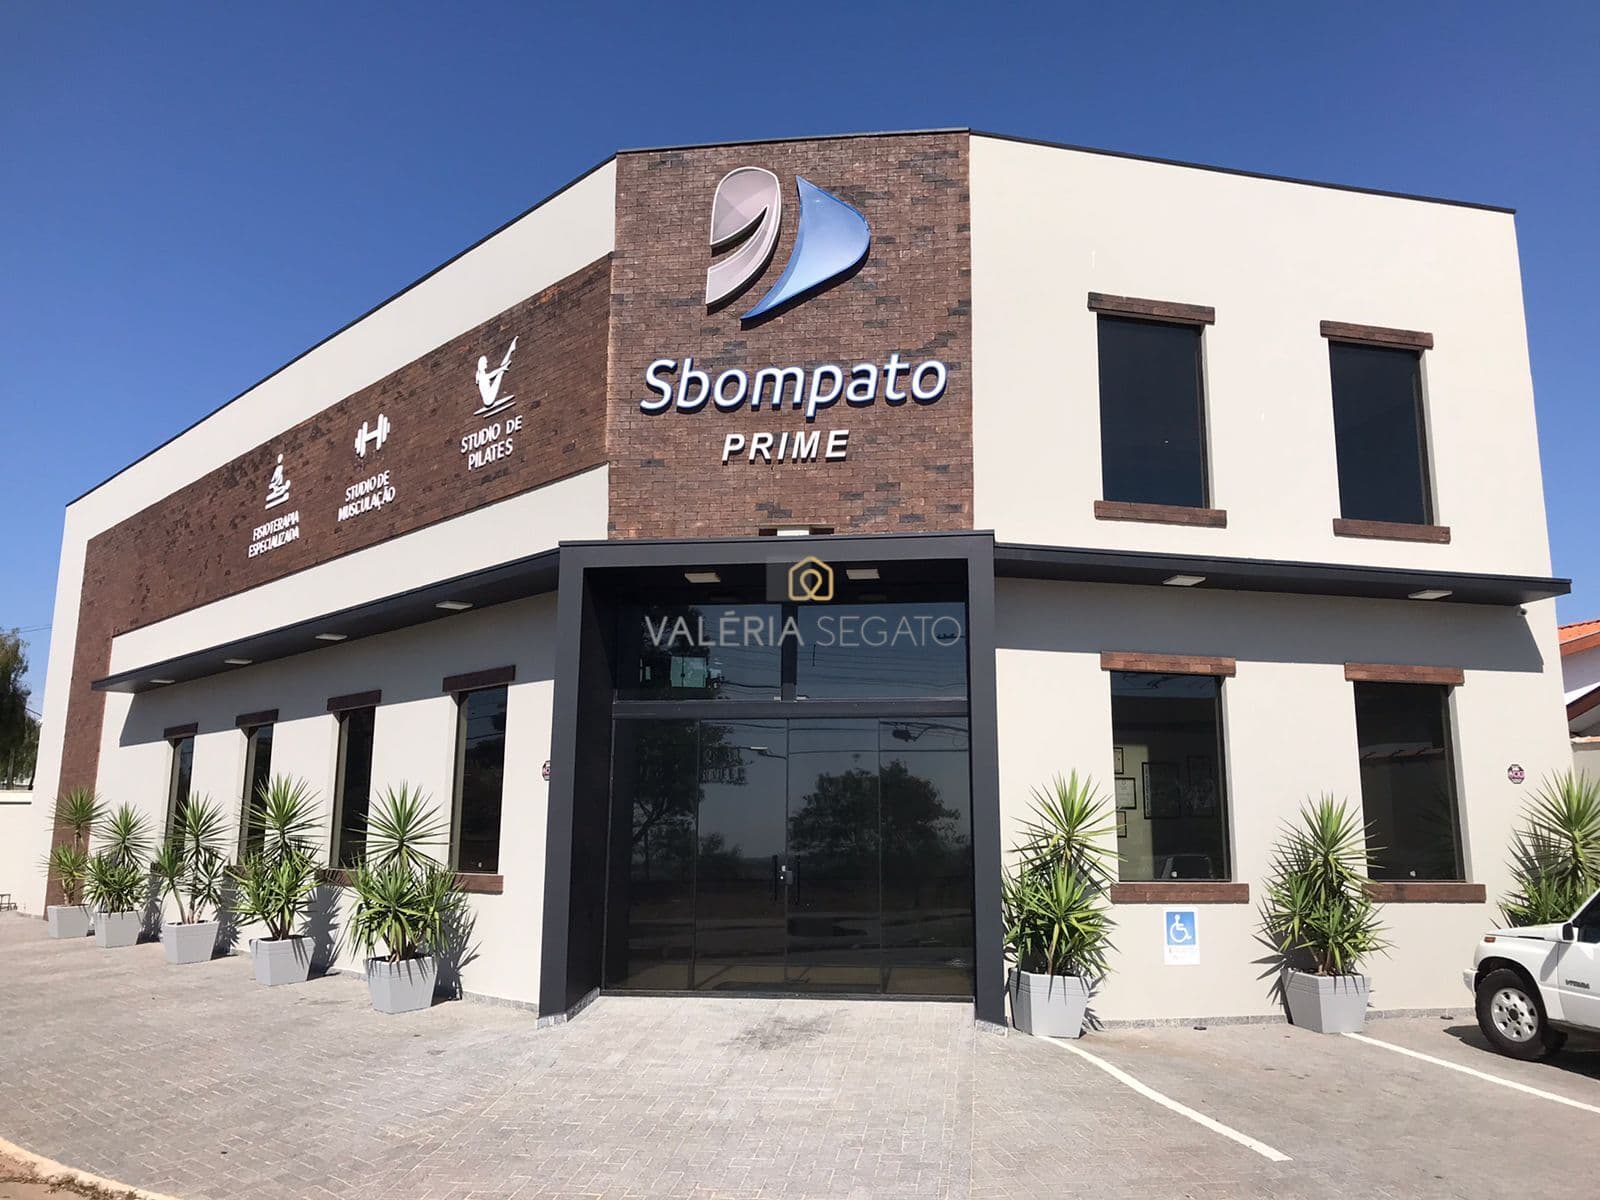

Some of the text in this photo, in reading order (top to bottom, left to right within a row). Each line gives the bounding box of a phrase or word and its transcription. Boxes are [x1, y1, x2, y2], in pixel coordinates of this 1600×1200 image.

[640, 354, 948, 420] Sbompato
[460, 415, 523, 453] STUDIO DE
[721, 429, 850, 463] PRIME
[467, 438, 513, 471] PILATES
[345, 469, 390, 502] STUDIO DE
[337, 486, 396, 522] MUSCULAÇÃO
[248, 525, 300, 558] ESPECIALIZADA
[252, 510, 300, 542] FISIOTERAPIA
